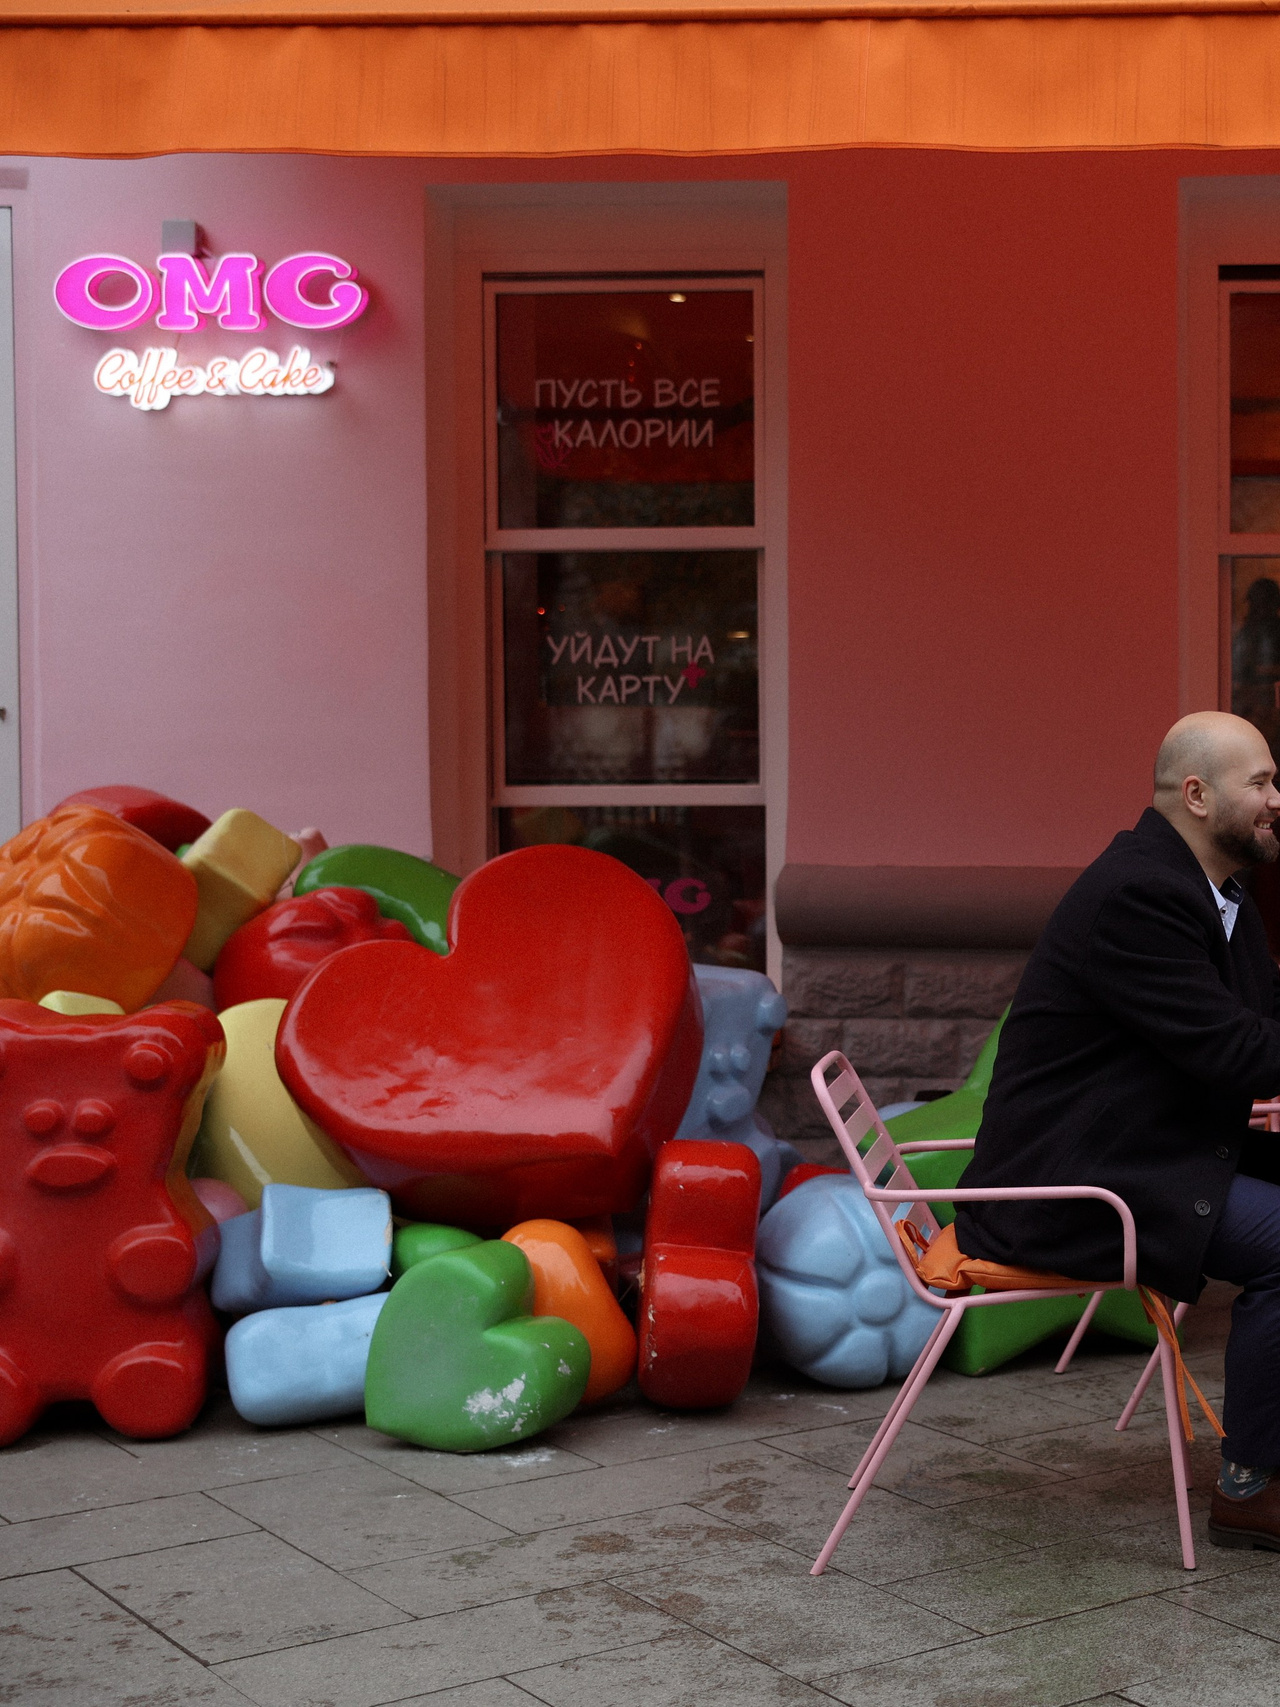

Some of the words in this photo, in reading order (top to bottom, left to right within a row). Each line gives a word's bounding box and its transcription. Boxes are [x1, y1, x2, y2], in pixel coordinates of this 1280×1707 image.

[54, 252, 367, 332] OMG
[95, 348, 202, 410] Coffee
[205, 358, 237, 393] &
[238, 346, 328, 393] Cake
[534, 378, 643, 409] ПУСТЬ
[653, 378, 721, 408] ВСЕ
[554, 419, 714, 449] КАЛОРИИ
[547, 631, 661, 669] УЙДУТ
[671, 634, 715, 664] НА
[577, 675, 686, 704] КАРТУ
